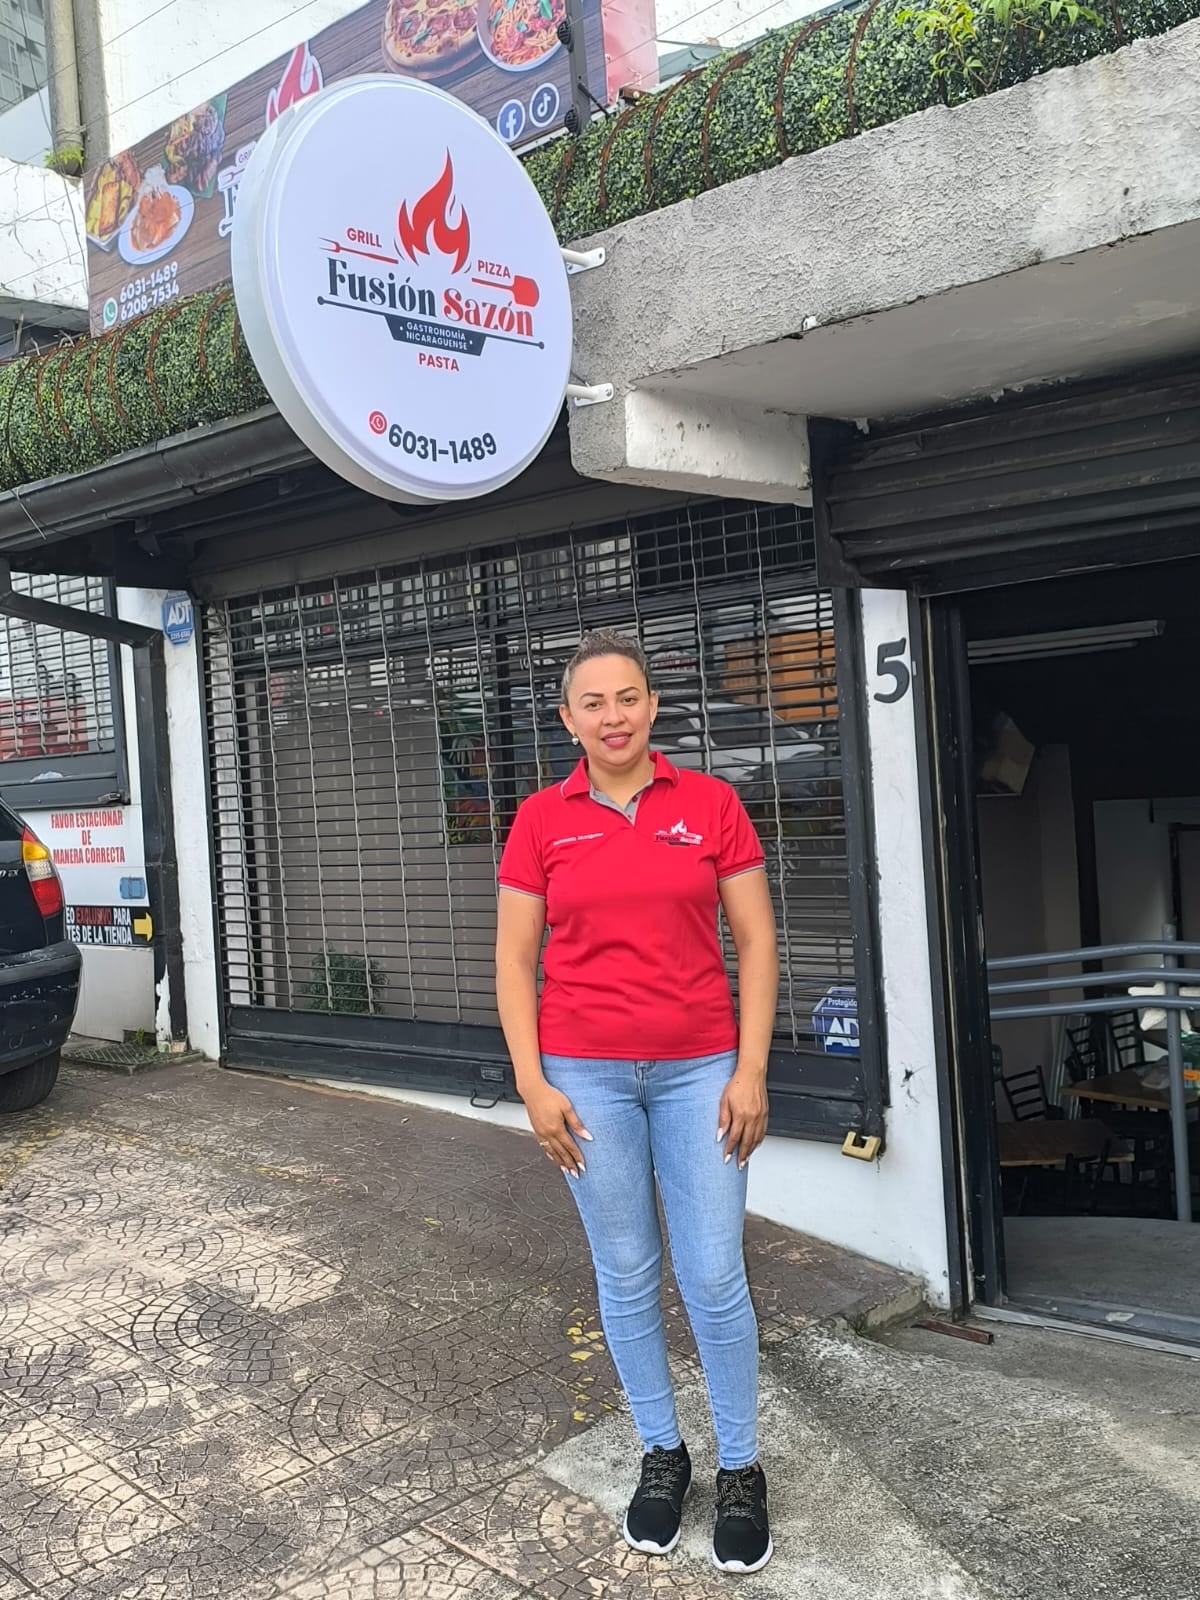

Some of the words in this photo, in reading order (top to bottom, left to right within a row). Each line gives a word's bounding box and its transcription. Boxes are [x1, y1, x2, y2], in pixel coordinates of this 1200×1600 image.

[346, 227, 382, 248] GRILL
[478, 259, 511, 279] PIZZA
[120, 261, 178, 303] 6031-1489
[121, 279, 179, 321] 6208-7534
[328, 257, 436, 317] Fusión
[443, 288, 533, 337] Sazón
[406, 331, 468, 350] NICARAGUENSE
[418, 352, 459, 372] PASTA
[388, 423, 497, 464] 6031-1489
[167, 600, 191, 627] ADT
[873, 636, 910, 704] 5
[51, 813, 75, 829] FAVOR
[76, 810, 123, 828] ESTACIONAR
[82, 829, 92, 846] DE
[53, 848, 84, 865] MANERA
[85, 846, 125, 864] CORRECTA
[113, 908, 132, 926] PARA
[82, 926, 92, 943] DE
[93, 926, 103, 943] LA
[104, 926, 133, 945] TIENDA
[826, 1016, 860, 1047] AD
